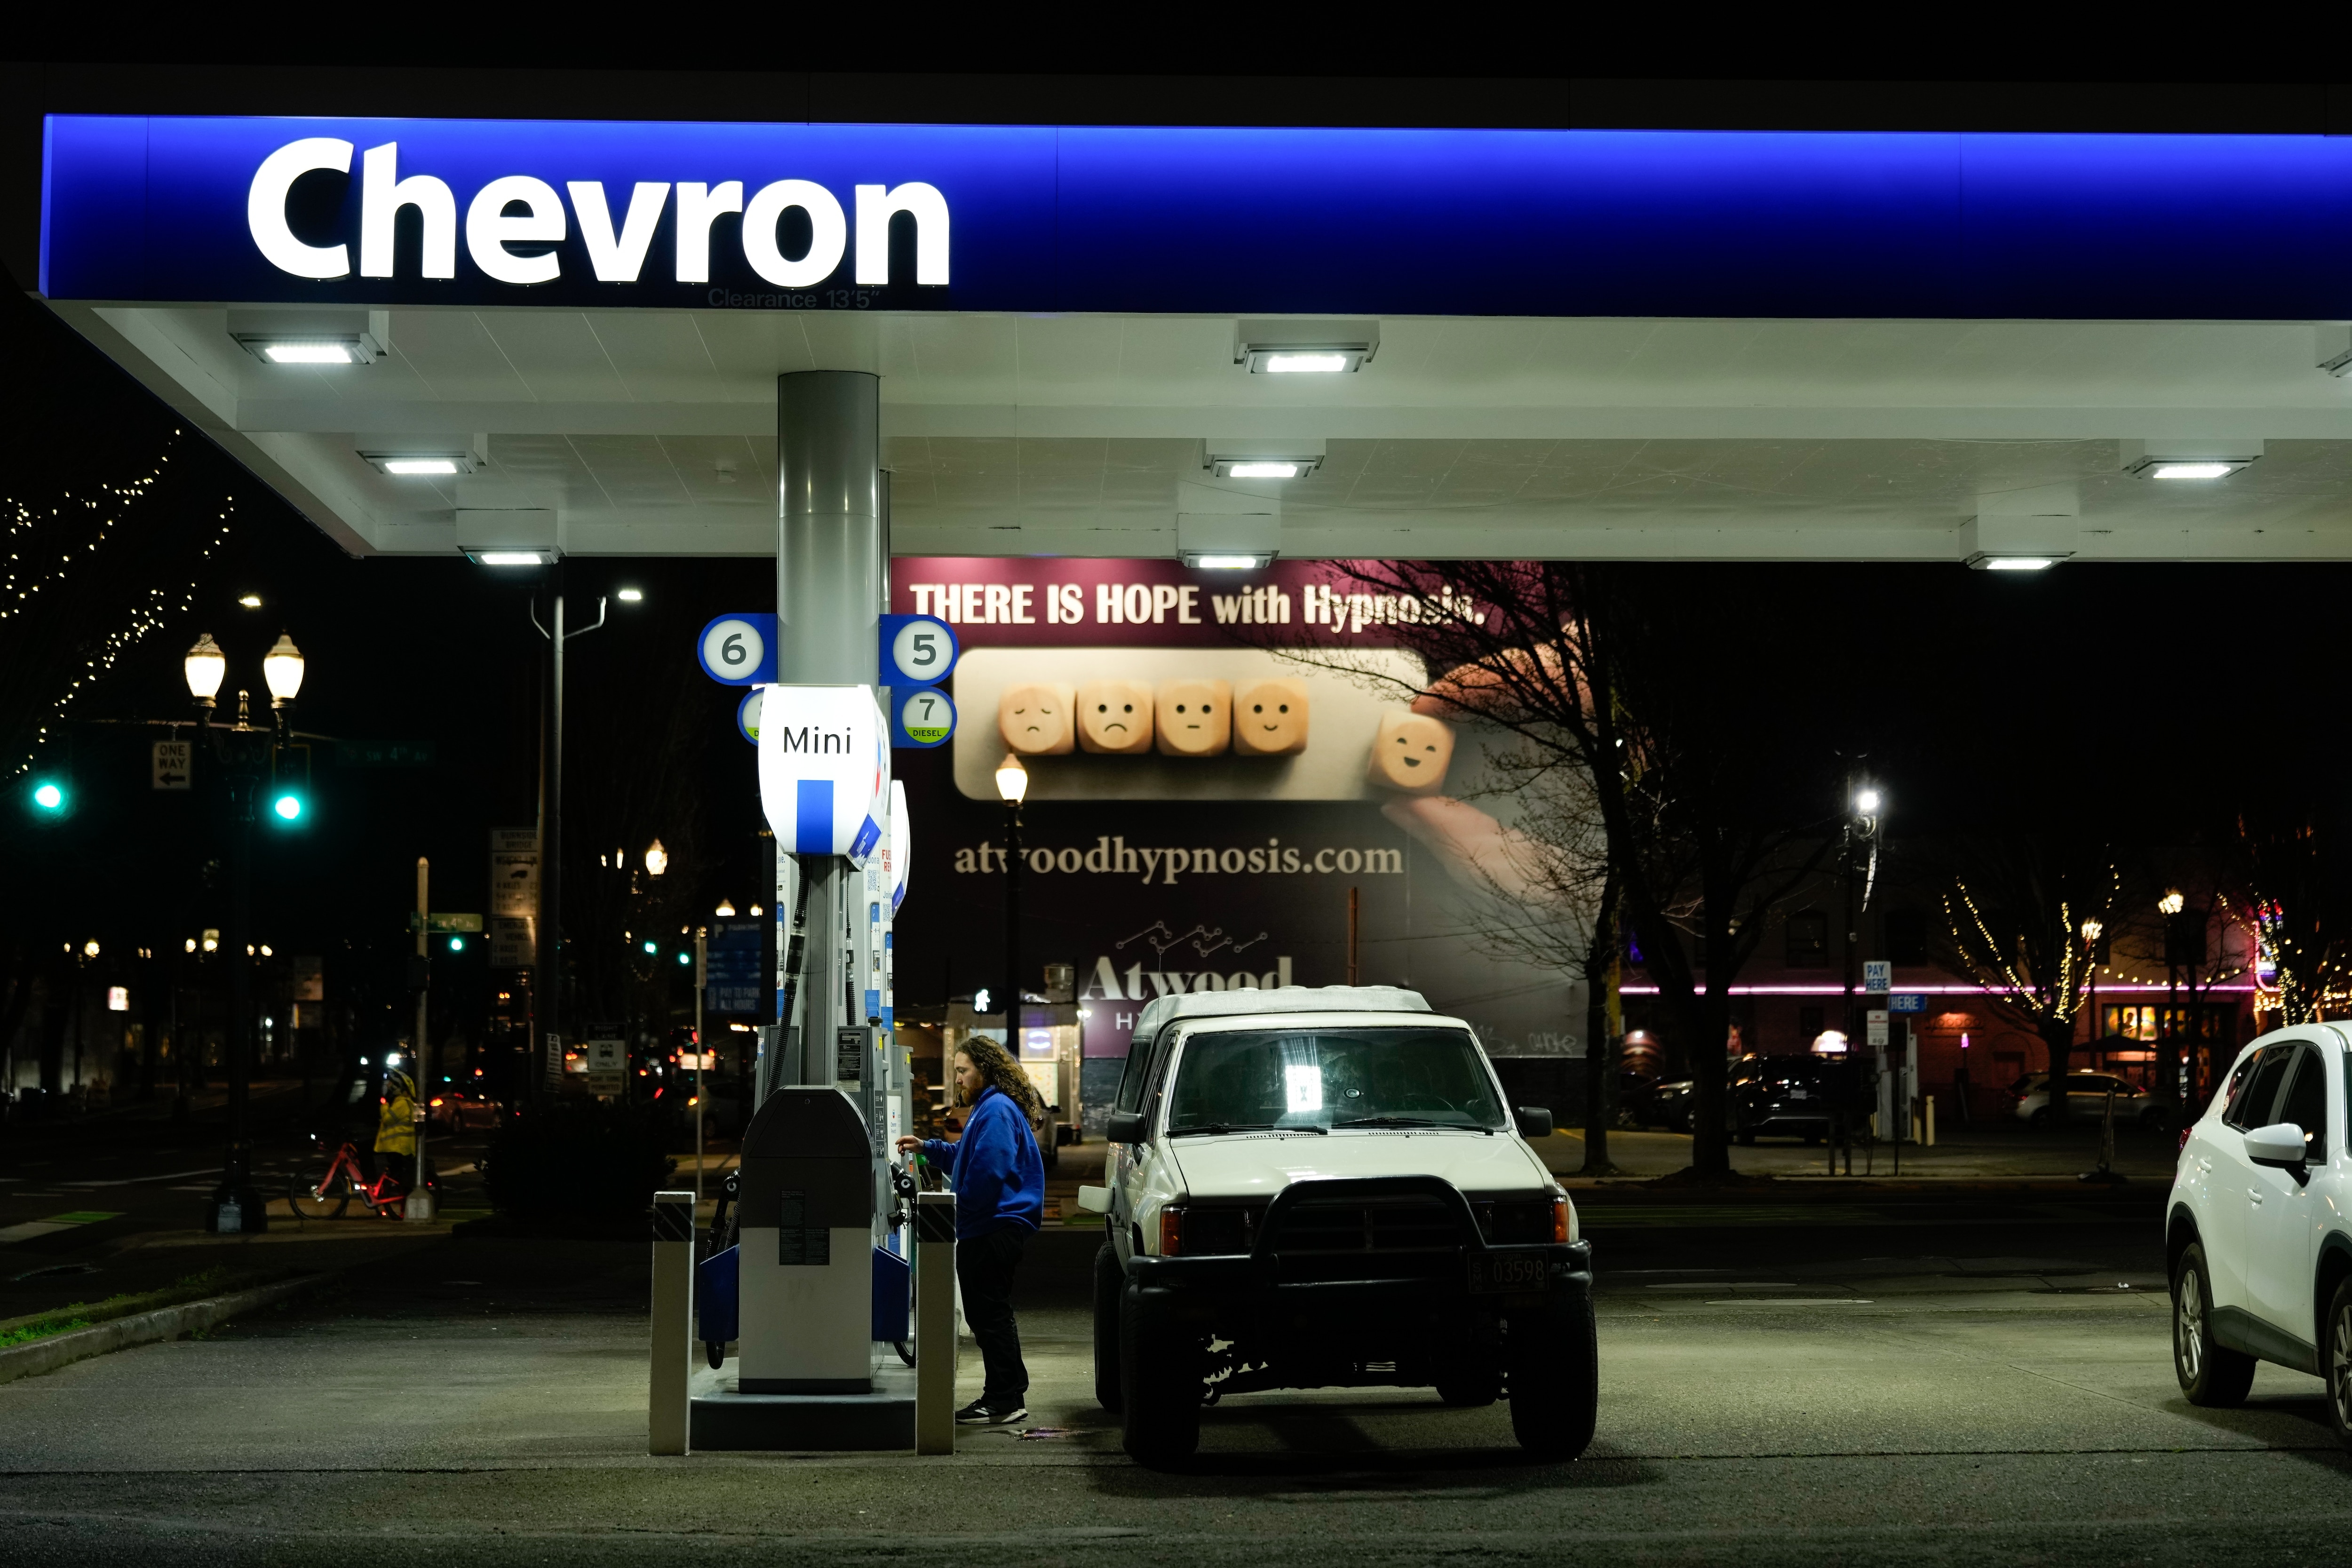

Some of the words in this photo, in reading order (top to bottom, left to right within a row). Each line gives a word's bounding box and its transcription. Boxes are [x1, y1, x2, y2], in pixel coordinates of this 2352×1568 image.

[248, 137, 950, 288] Chevron
[707, 288, 817, 308] Clearance
[909, 583, 1036, 624] THERE
[1047, 583, 1084, 625] IS
[1096, 583, 1201, 624] HOPE
[1211, 585, 1290, 624] with
[722, 633, 747, 665] 6
[912, 634, 937, 666] 5
[919, 699, 935, 721] 7
[159, 744, 185, 756] ONE
[784, 726, 851, 754] Mini
[159, 757, 186, 769] WAY
[1077, 955, 1293, 1001] Atwood
[1867, 964, 1884, 977] PAY
[1866, 978, 1887, 990] HERE
[1891, 995, 1919, 1010] HERE
[1494, 1253, 1521, 1261] Oregon
[1494, 1260, 1545, 1282] 03598
